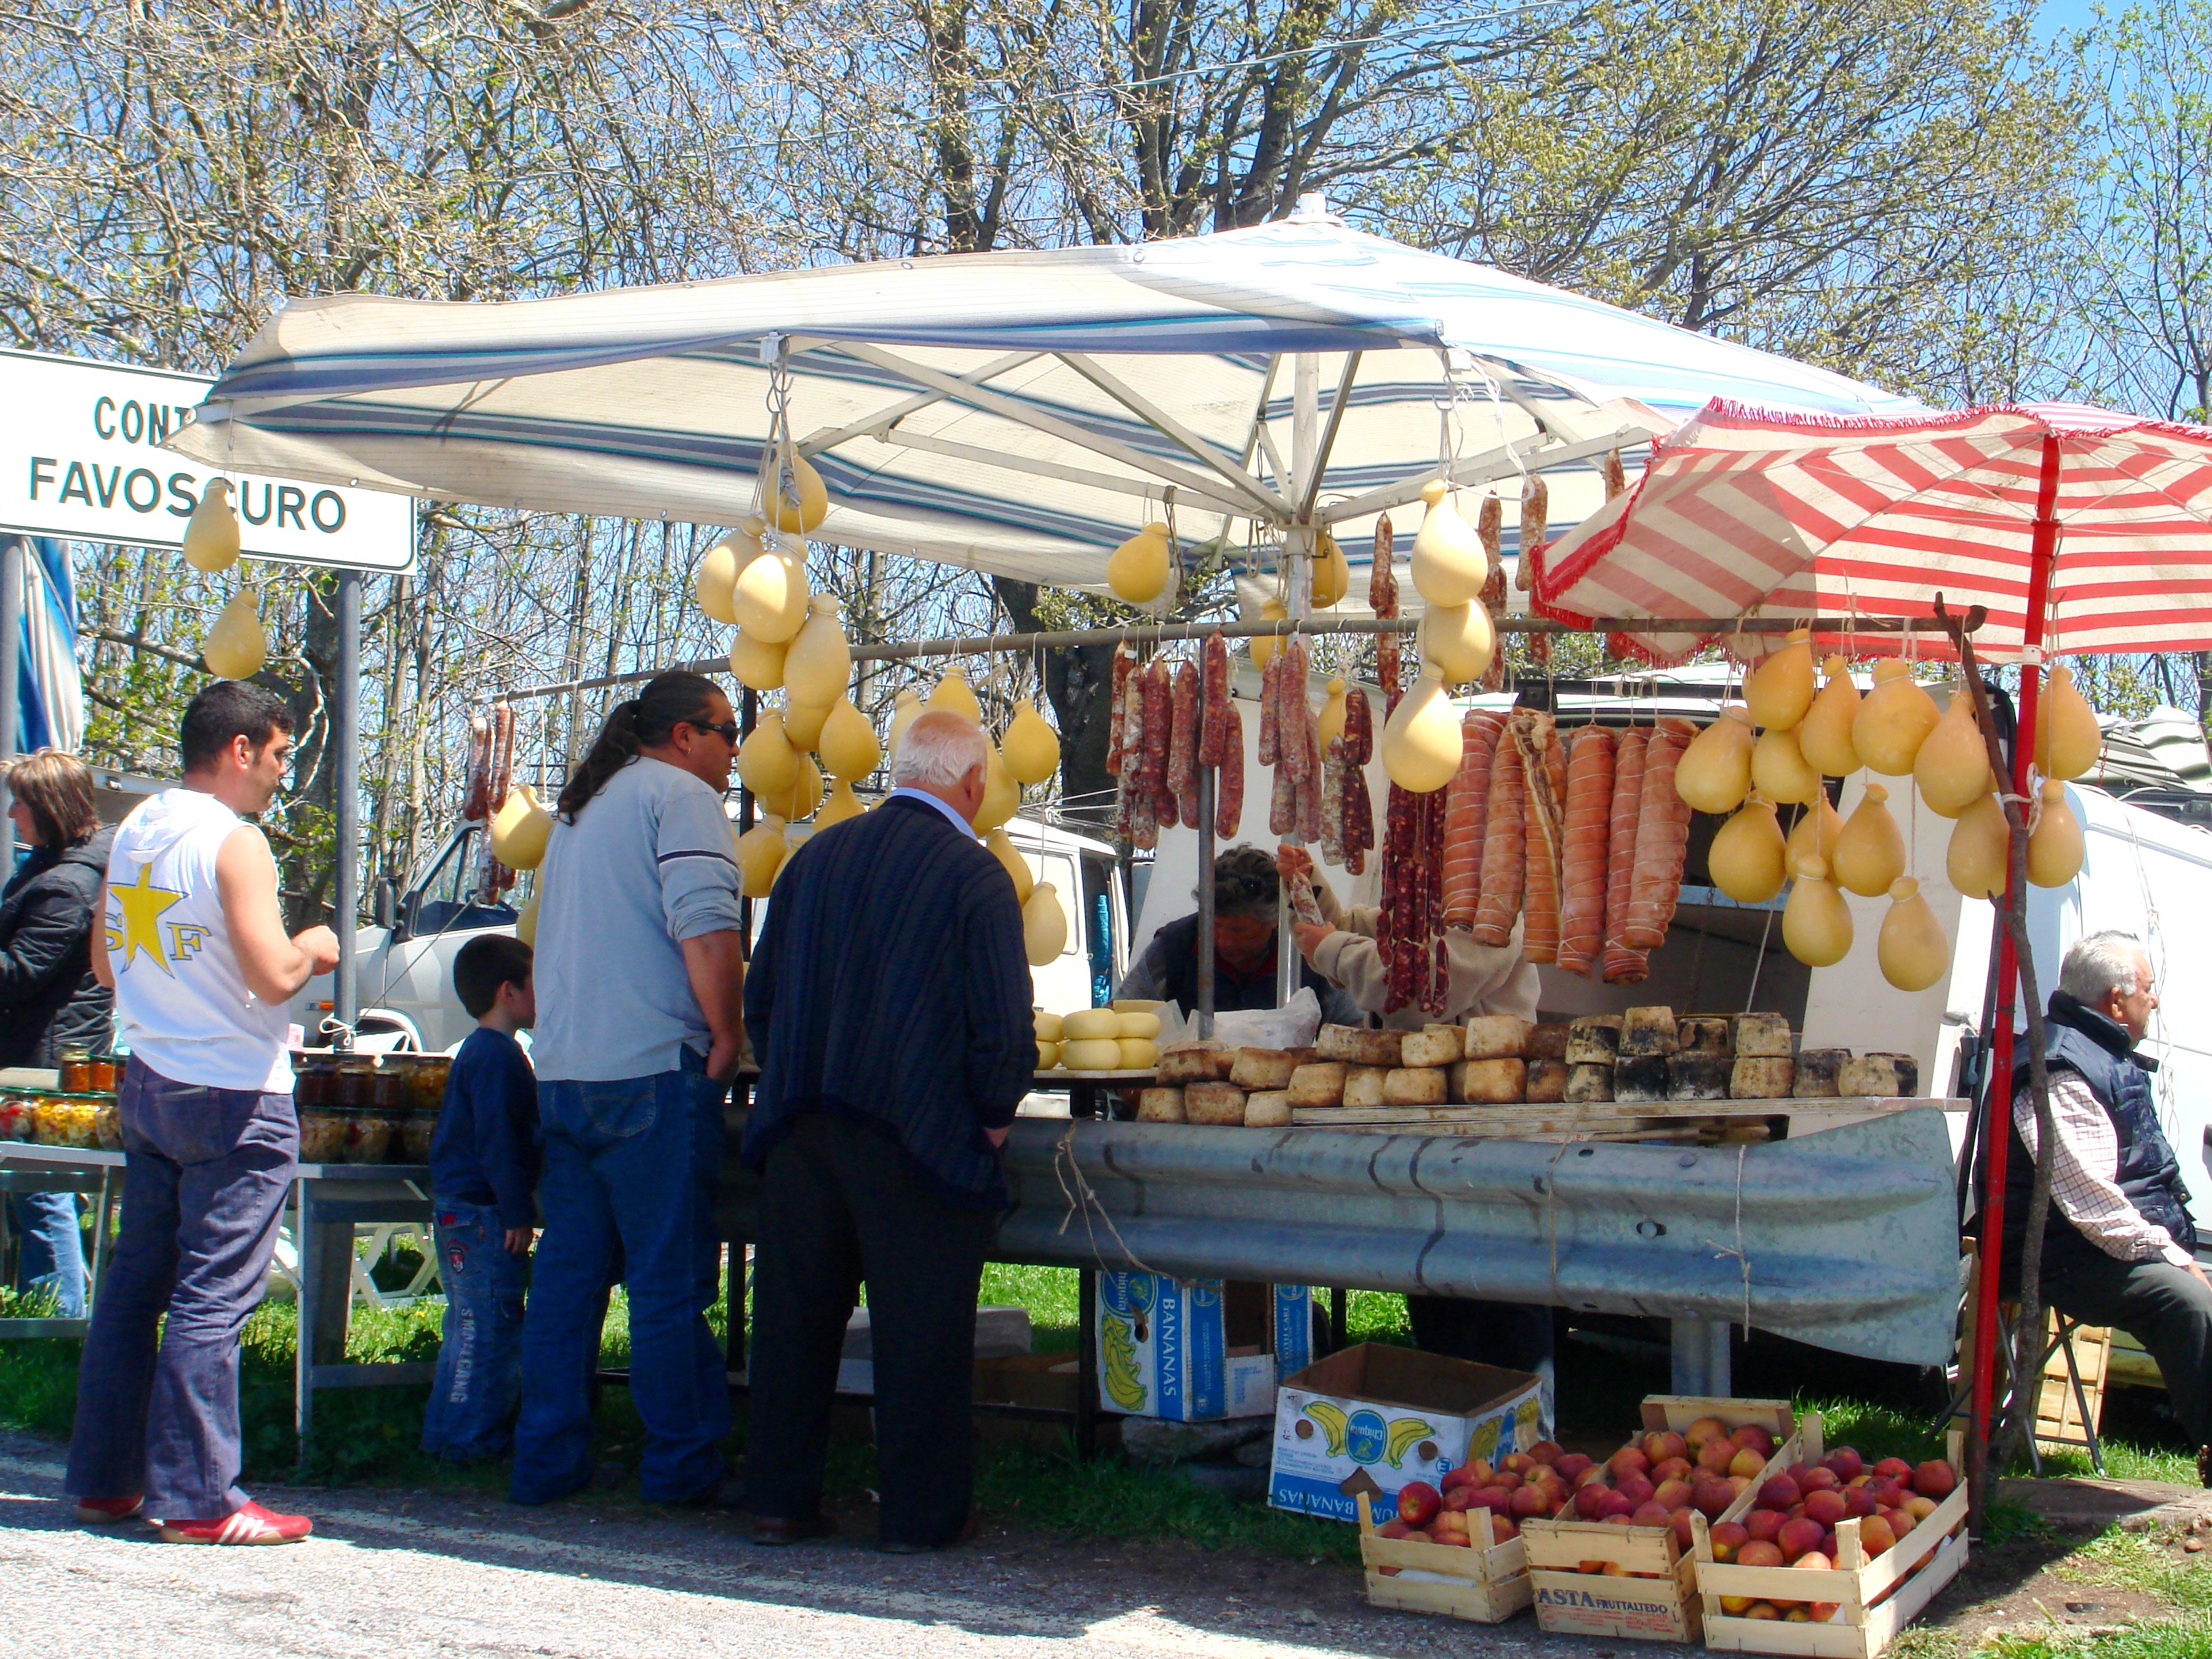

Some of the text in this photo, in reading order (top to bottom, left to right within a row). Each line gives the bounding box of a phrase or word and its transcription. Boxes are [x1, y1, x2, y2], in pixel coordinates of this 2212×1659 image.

[166, 922, 212, 960] F
[1118, 1271, 1128, 1311] hiquita
[1162, 1298, 1176, 1397] BANANAS
[1279, 1489, 1354, 1515] BANANAS
[1538, 1588, 1595, 1607] ASTA
